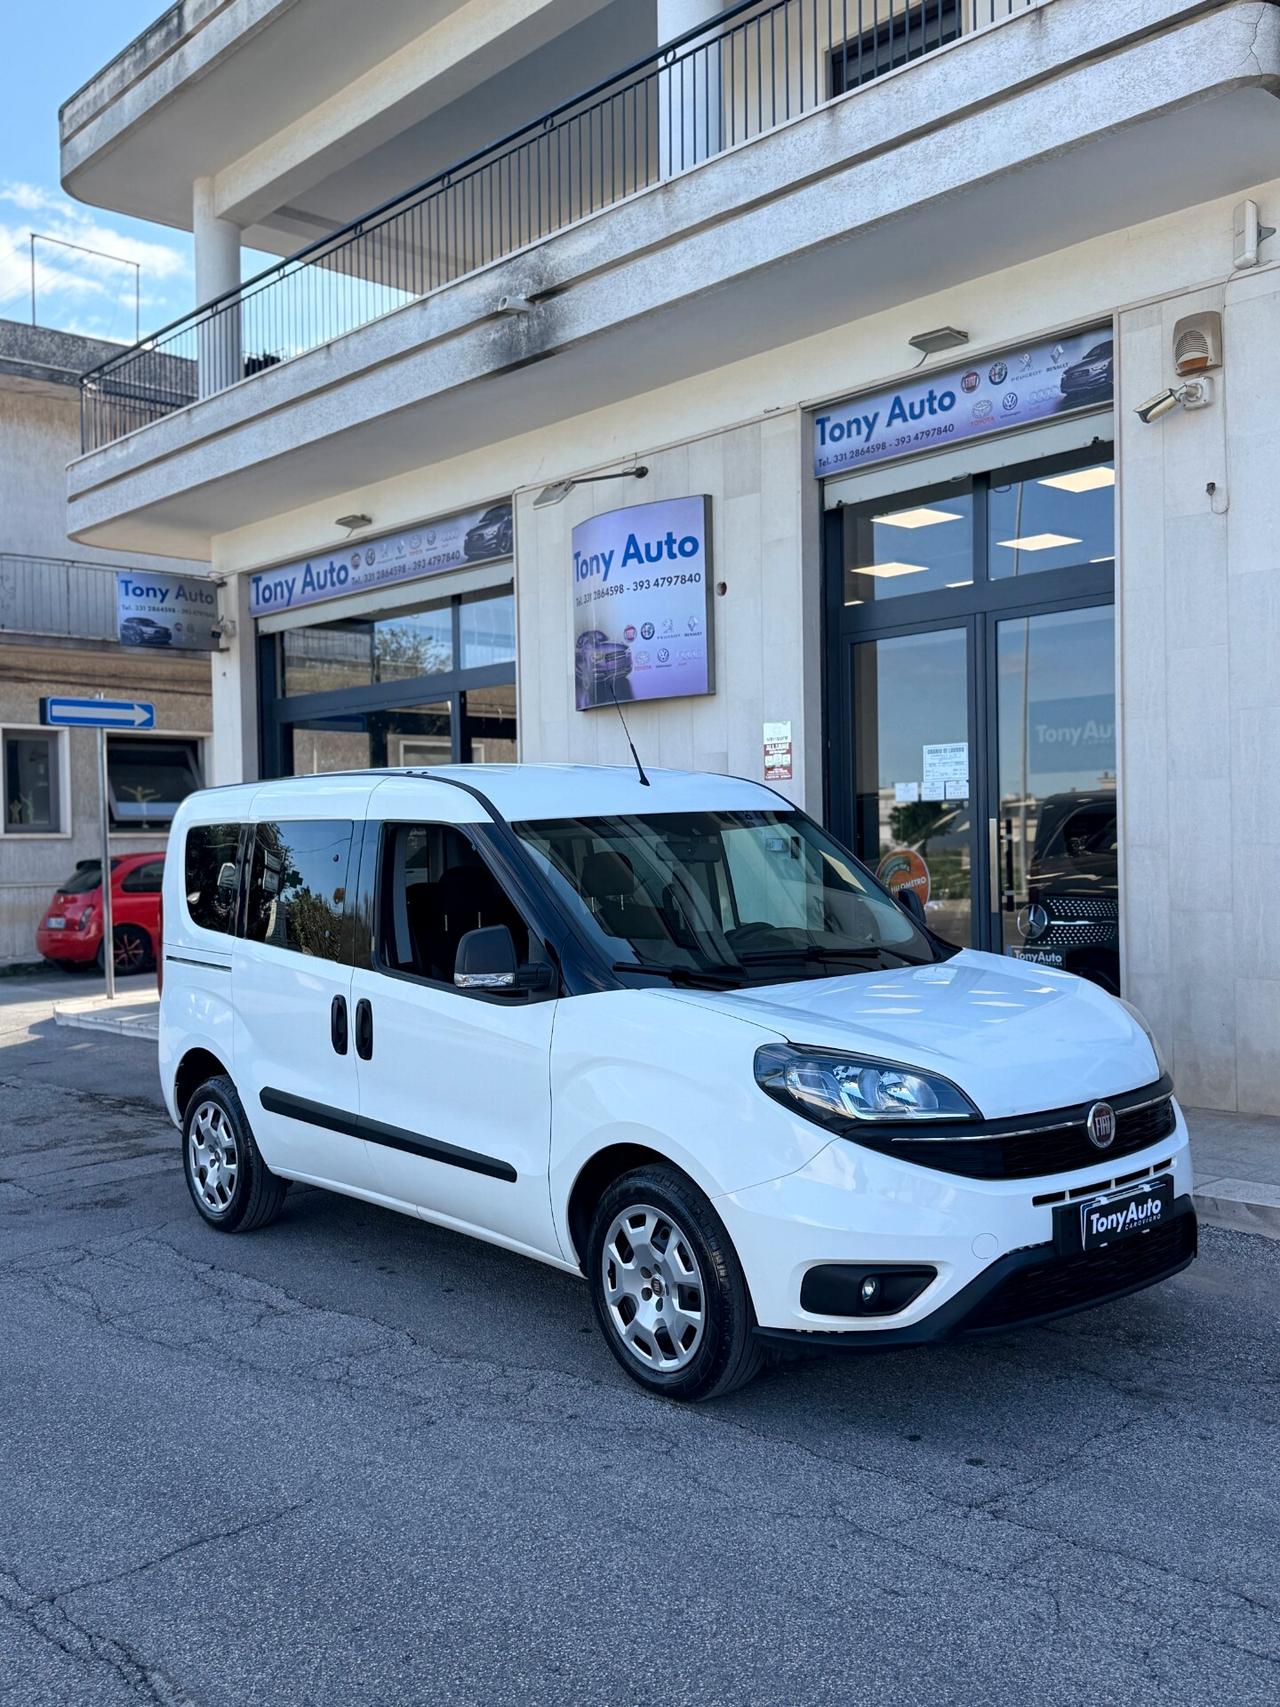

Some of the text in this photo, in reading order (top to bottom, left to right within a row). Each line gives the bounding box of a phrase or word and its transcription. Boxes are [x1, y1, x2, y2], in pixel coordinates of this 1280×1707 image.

[816, 389, 956, 446] Tony Auto
[819, 458, 832, 468] Tel.
[834, 453, 848, 463] 331
[849, 441, 887, 460] 2864598
[895, 435, 911, 447] 393
[913, 423, 955, 441] 4797840
[376, 564, 406, 580] 2864598
[413, 559, 426, 571] 393
[428, 550, 460, 566] 4797840
[574, 532, 700, 583] Tony Auto
[120, 580, 215, 605] Tony Auto
[252, 561, 349, 606] Tony Auto
[593, 584, 624, 600] 2864598
[632, 579, 651, 592] 393
[653, 572, 701, 588] 4797840
[1036, 720, 1116, 747] TonyAu
[1014, 950, 1062, 963] TonyAuto
[1095, 1115, 1111, 1136] FIAT
[1090, 1199, 1162, 1234] TonyAuto
[1125, 1213, 1161, 1231] CAROVIGNO
